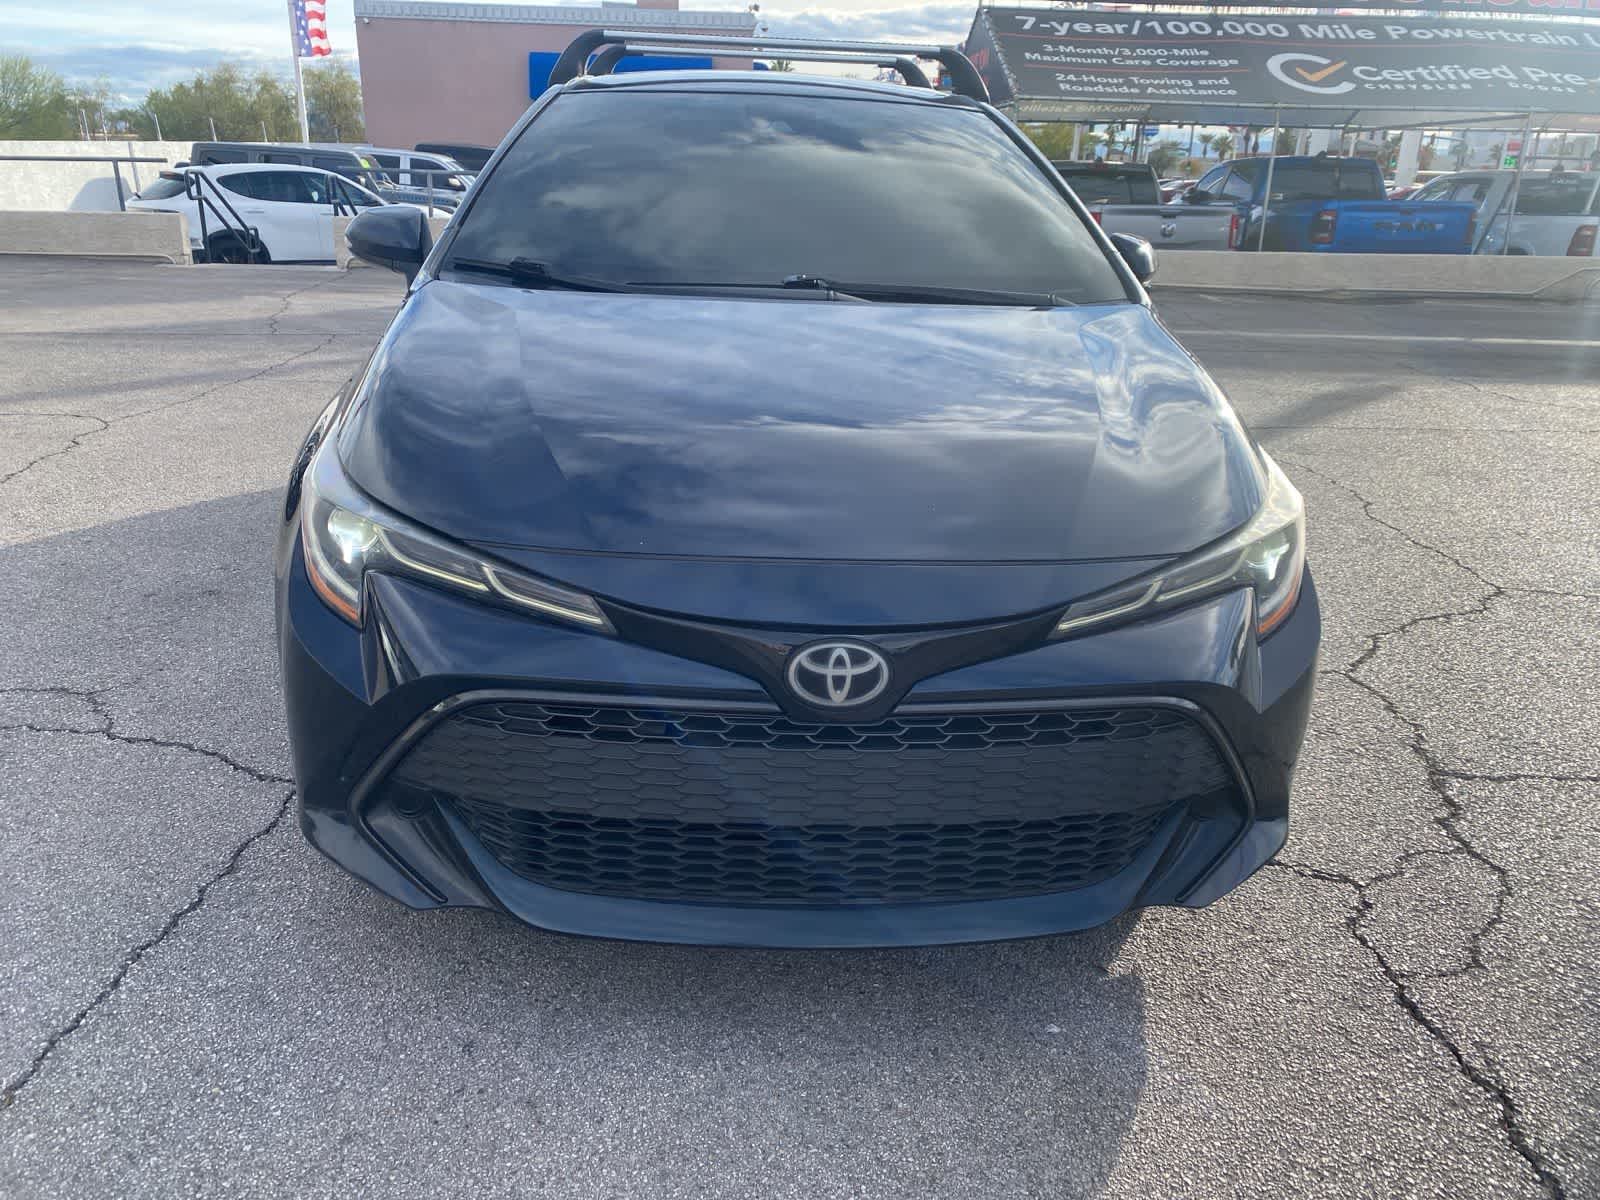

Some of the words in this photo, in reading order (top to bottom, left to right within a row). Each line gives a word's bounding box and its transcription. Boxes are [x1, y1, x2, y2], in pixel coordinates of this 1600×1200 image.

[1300, 24, 1377, 40] Mile
[1383, 25, 1579, 47] Powertrain
[1024, 52, 1108, 64] Maximum
[1111, 57, 1151, 66] Care
[1155, 57, 1240, 67] Coverage
[1055, 73, 1125, 85] 24-Hour
[1129, 76, 1194, 87] Towing
[1197, 77, 1231, 86] and
[1352, 64, 1518, 81] Certified
[1058, 83, 1140, 94] Roadside
[1146, 86, 1238, 96] Assistance
